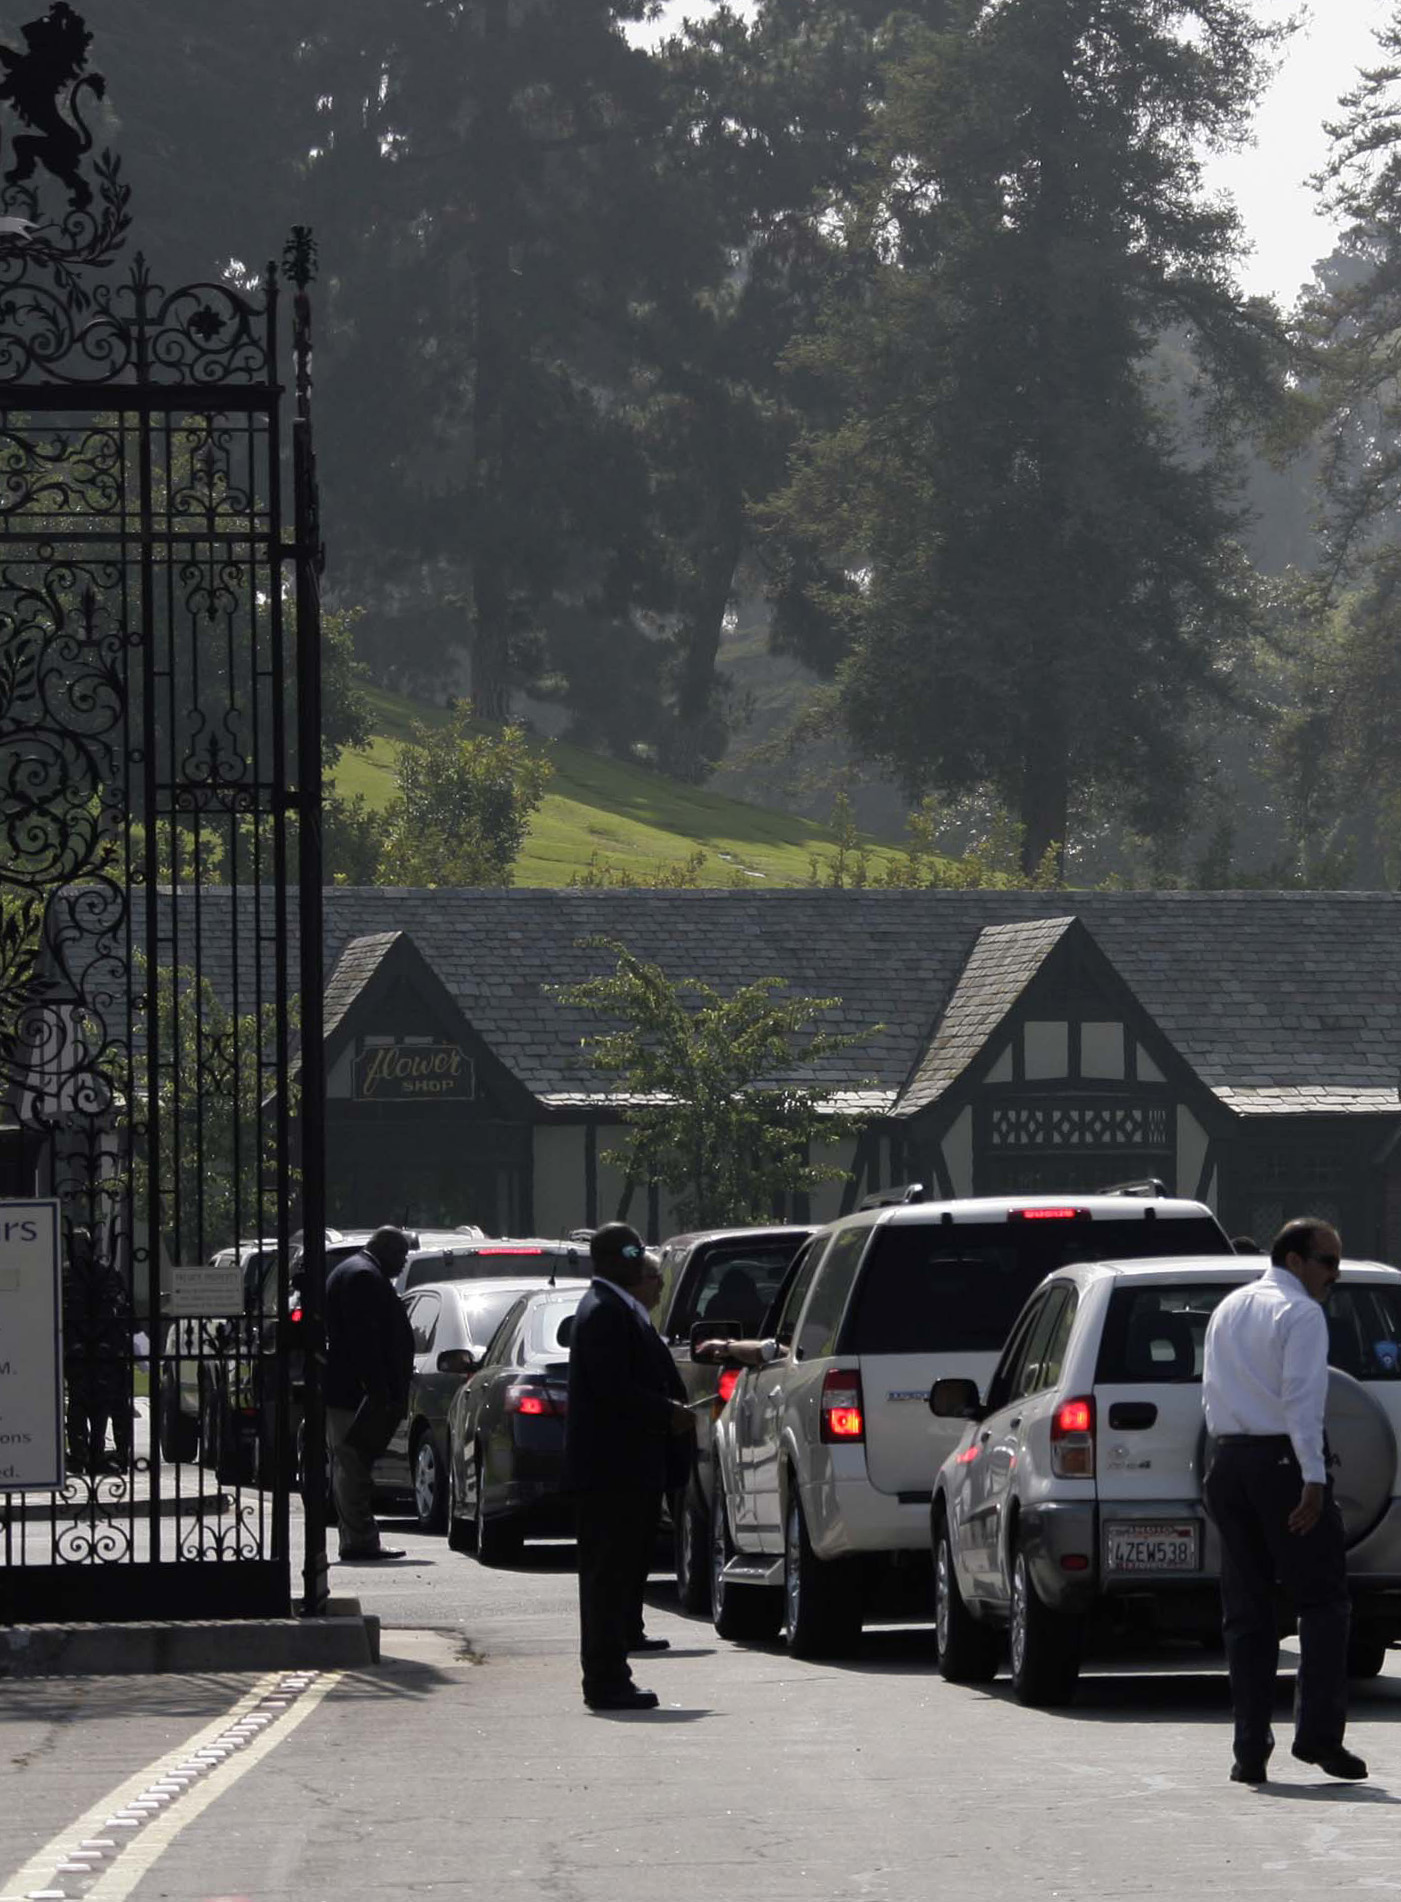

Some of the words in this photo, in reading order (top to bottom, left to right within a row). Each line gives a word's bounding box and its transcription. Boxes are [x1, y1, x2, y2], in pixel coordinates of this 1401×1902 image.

[402, 1079, 455, 1092] SHOP
[0, 1220, 38, 1242] rs
[1115, 1541, 1188, 1563] 4ZEW538
